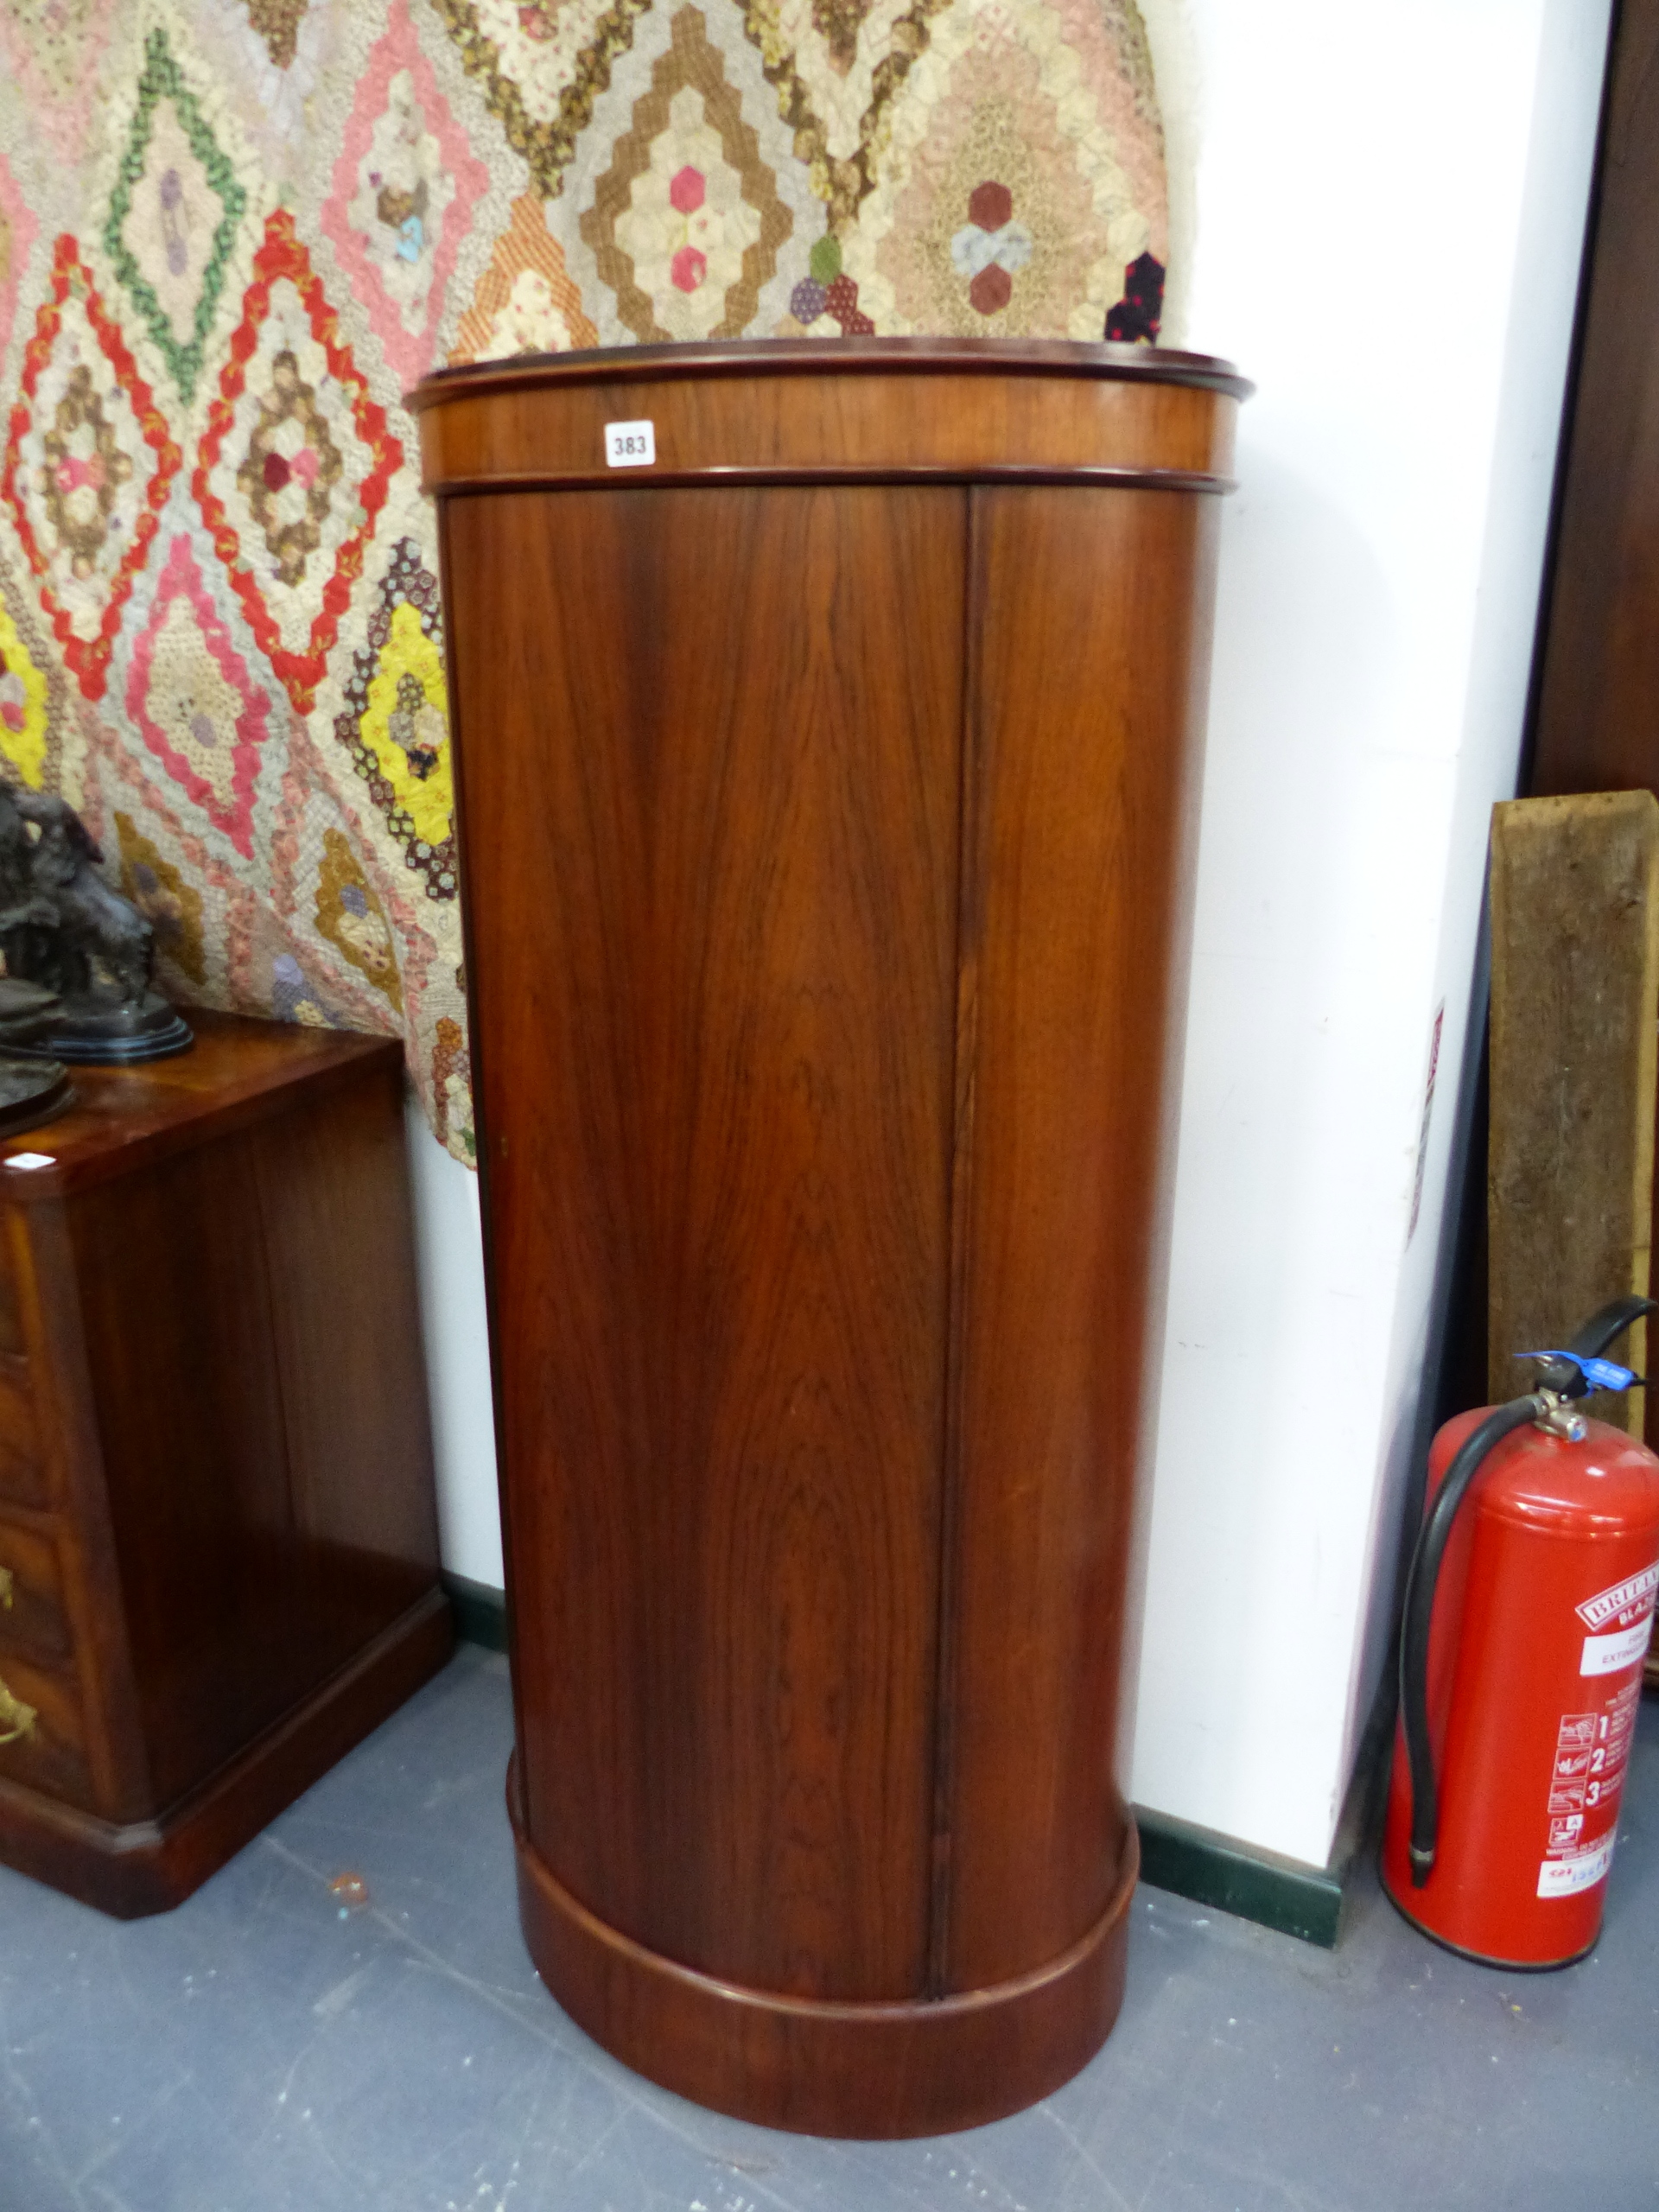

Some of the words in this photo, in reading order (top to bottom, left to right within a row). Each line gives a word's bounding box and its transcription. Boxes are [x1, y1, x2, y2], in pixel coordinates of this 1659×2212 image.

[614, 435, 646, 455] 383
[1599, 1715, 1609, 1739] 1
[1590, 1747, 1605, 1772] 2
[1586, 1781, 1600, 1806] 3
